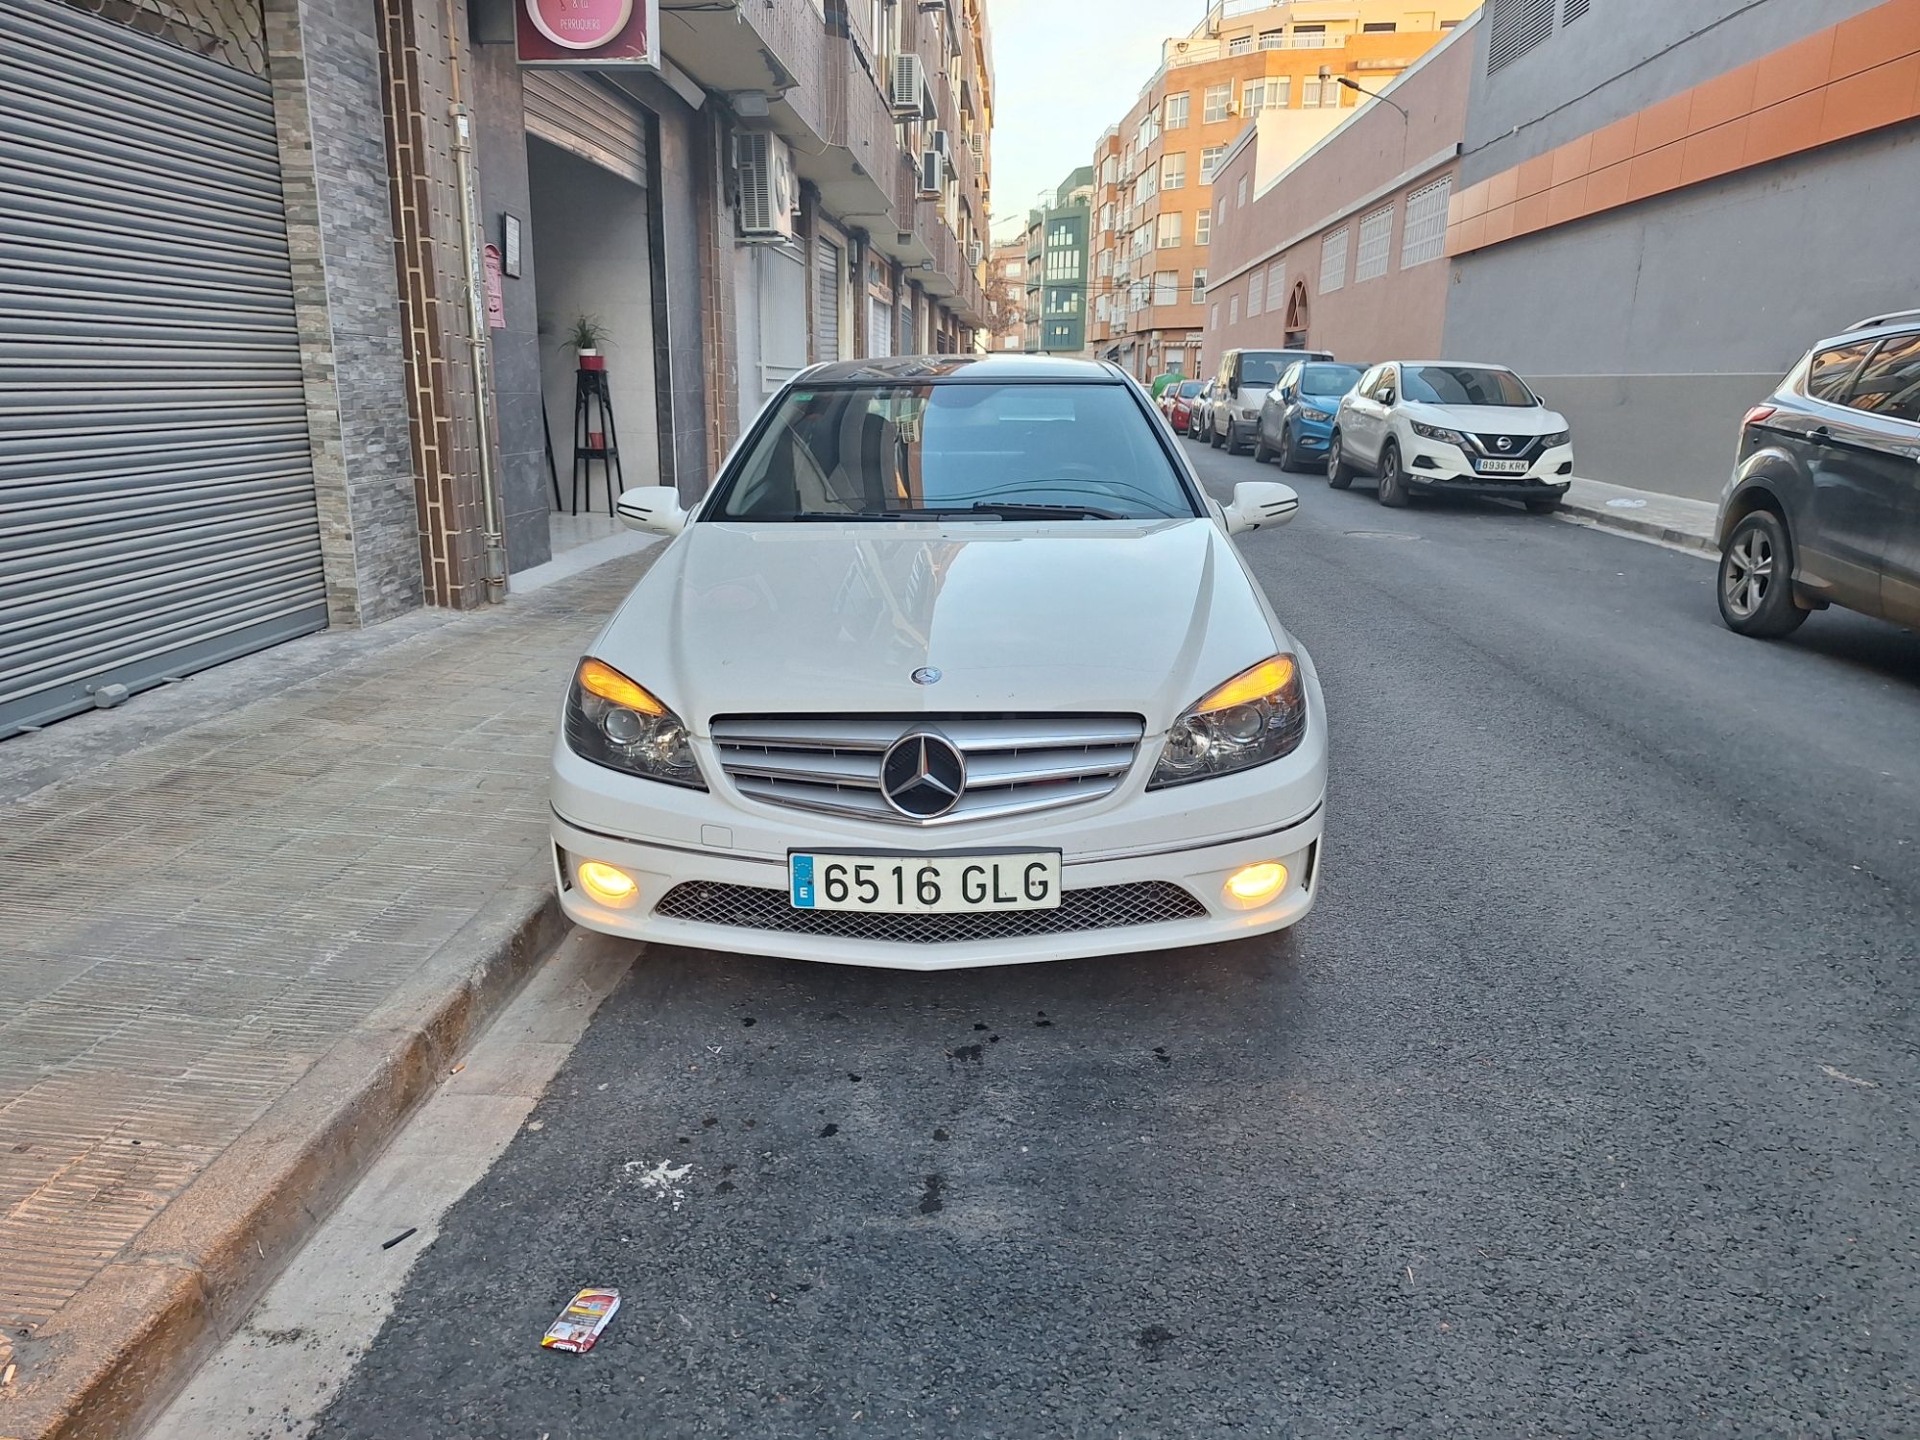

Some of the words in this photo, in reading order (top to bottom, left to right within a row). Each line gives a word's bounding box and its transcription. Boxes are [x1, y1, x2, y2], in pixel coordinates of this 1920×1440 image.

[1482, 460, 1507, 470] 8936
[1508, 460, 1527, 471] KRK
[824, 863, 942, 906] 6516
[961, 862, 1049, 904] GLG
[799, 886, 809, 899] E
